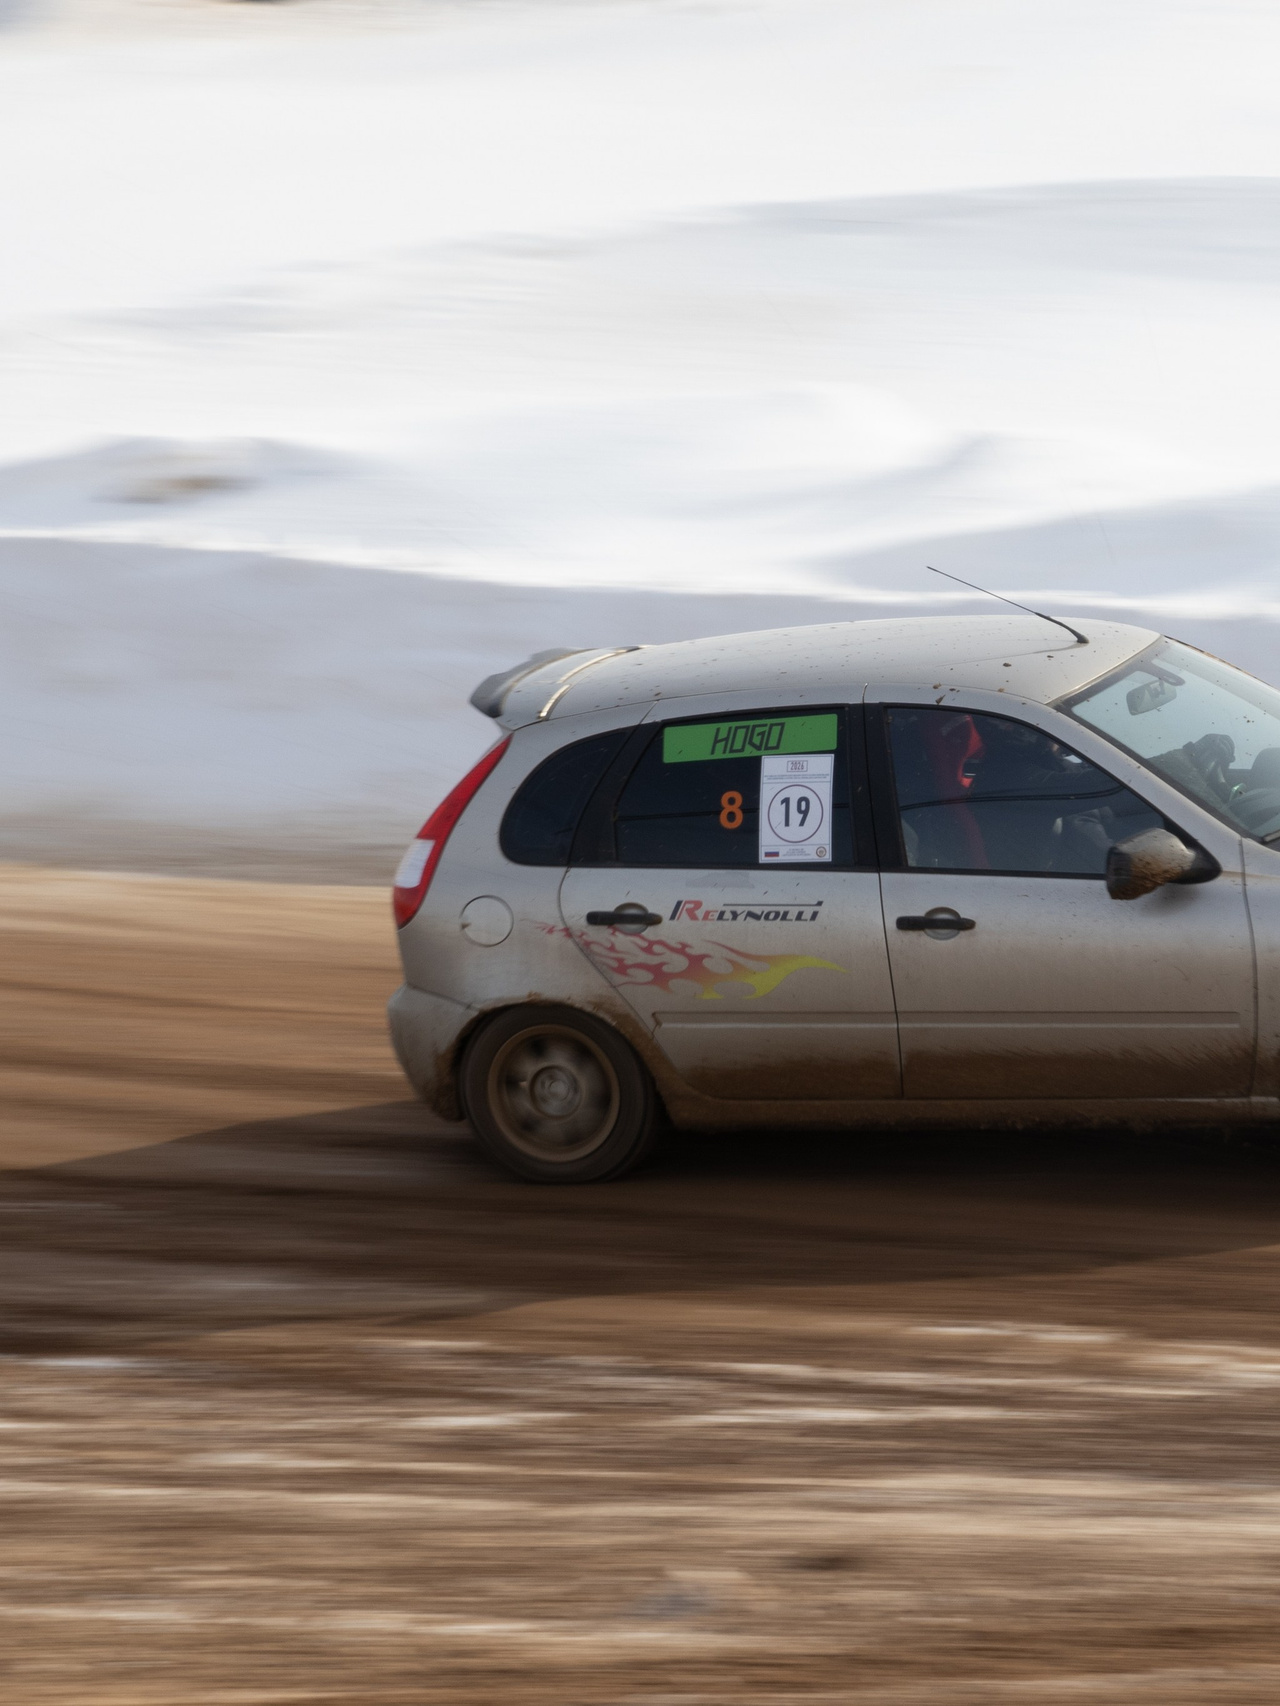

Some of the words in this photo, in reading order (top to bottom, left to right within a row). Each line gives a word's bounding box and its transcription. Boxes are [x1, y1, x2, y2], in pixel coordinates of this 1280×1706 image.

[711, 722, 785, 755] HOGO
[720, 791, 743, 829] 8
[780, 796, 810, 827] 19
